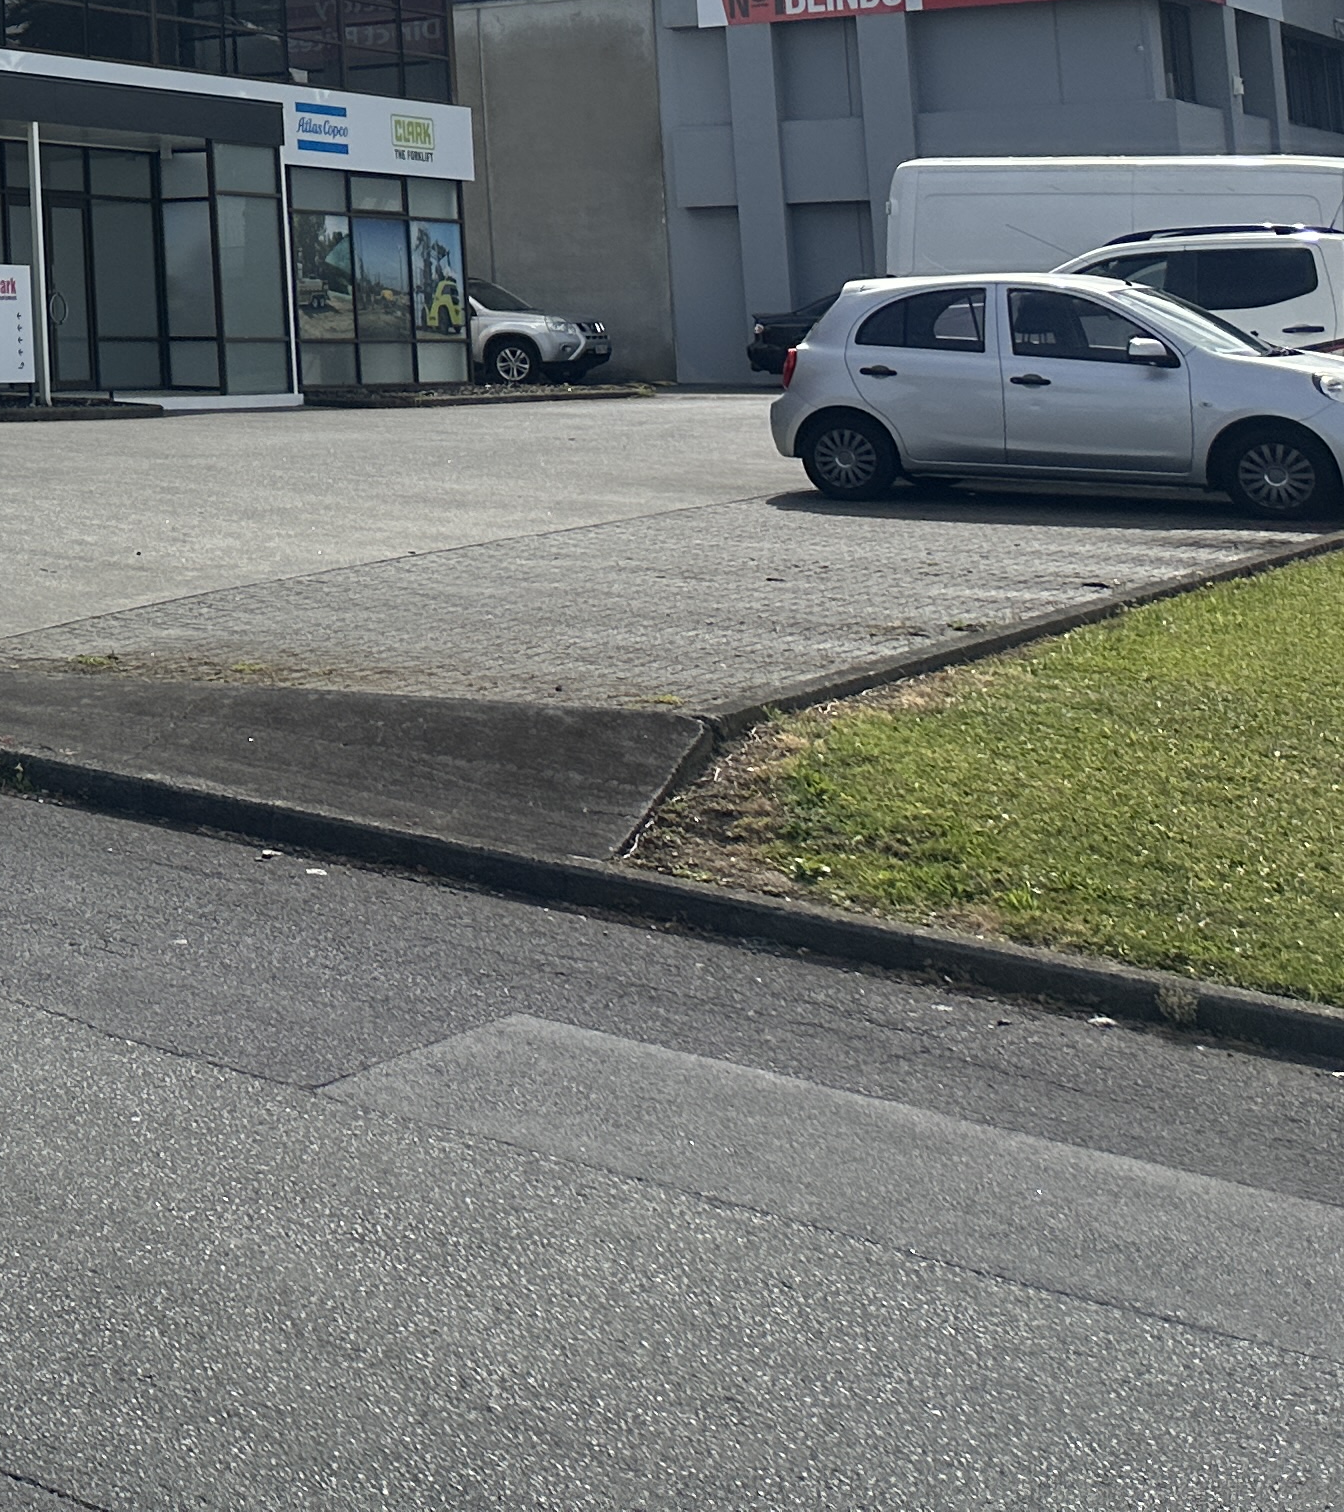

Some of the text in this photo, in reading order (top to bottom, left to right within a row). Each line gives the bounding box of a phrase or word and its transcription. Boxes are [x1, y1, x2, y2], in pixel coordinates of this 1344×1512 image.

[296, 116, 349, 139] Atlas Copco
[394, 119, 432, 146] CLARK
[394, 148, 434, 163] THE FORKLIFT
